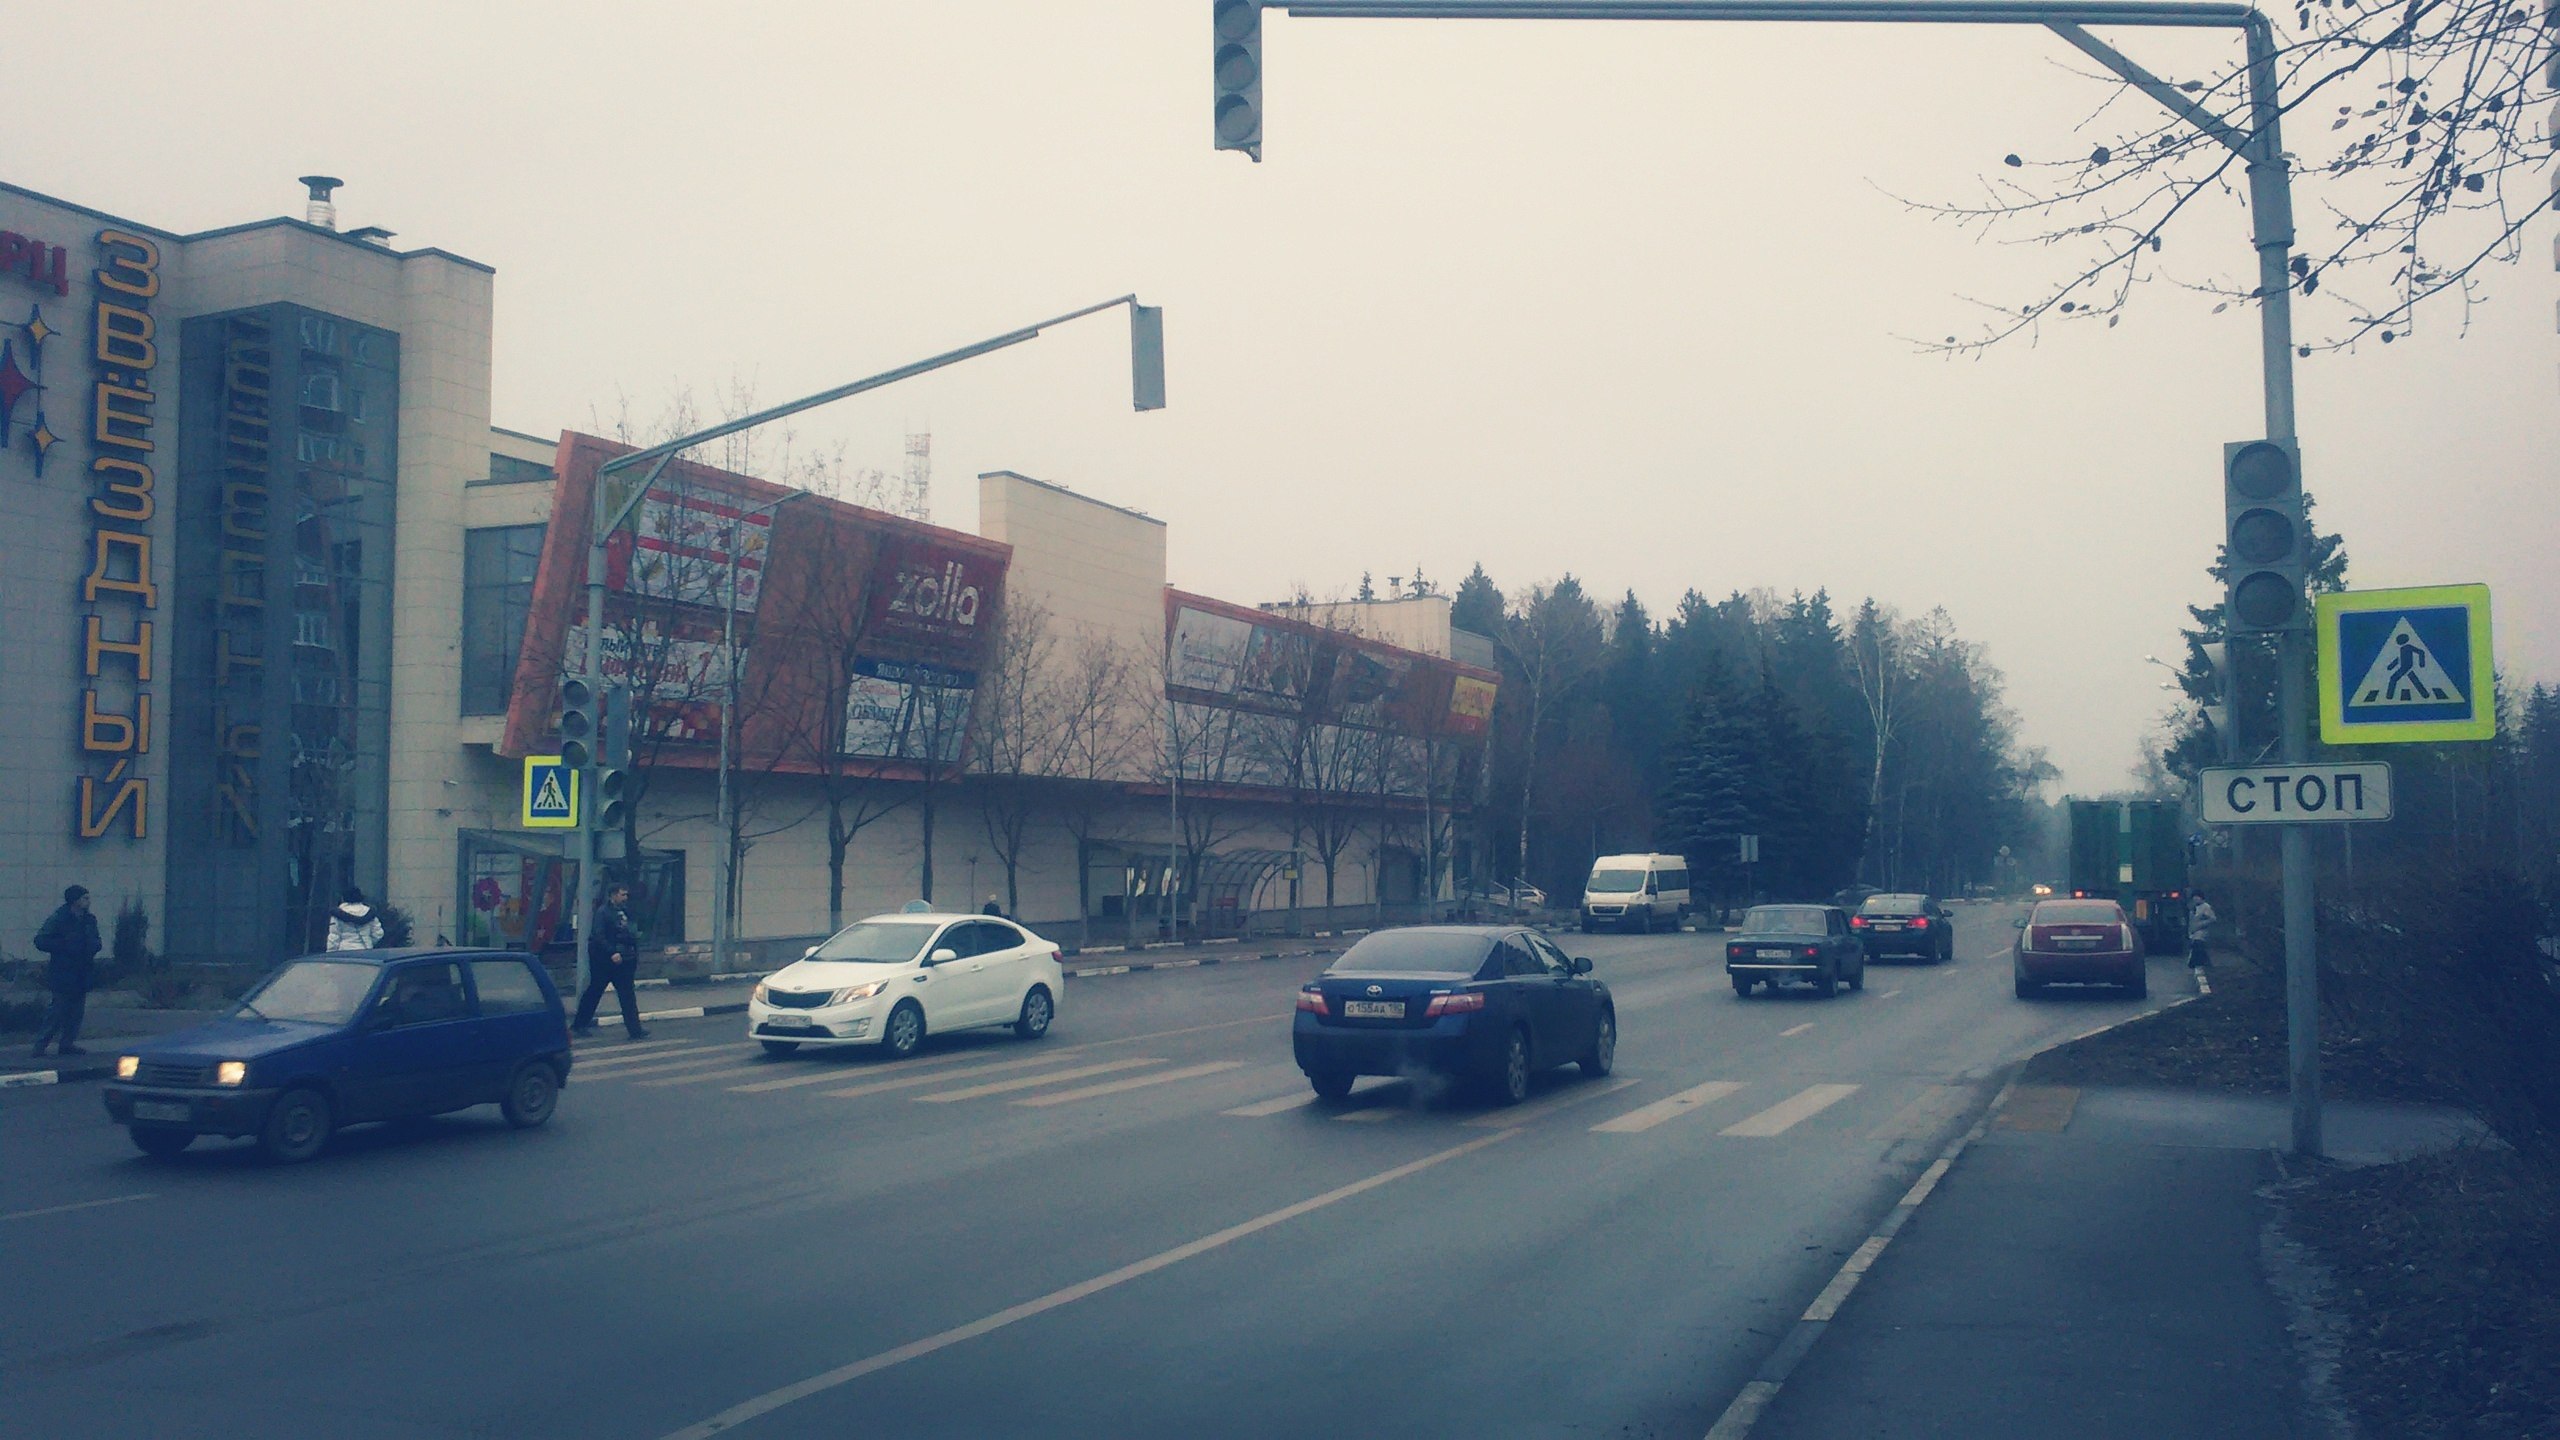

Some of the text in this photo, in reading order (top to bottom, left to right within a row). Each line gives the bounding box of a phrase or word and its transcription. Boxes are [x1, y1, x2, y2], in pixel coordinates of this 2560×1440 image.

[80, 229, 159, 839] ЗВЁЗДНЫЙ
[887, 560, 980, 626] zolla
[2227, 774, 2363, 813] СТОП
